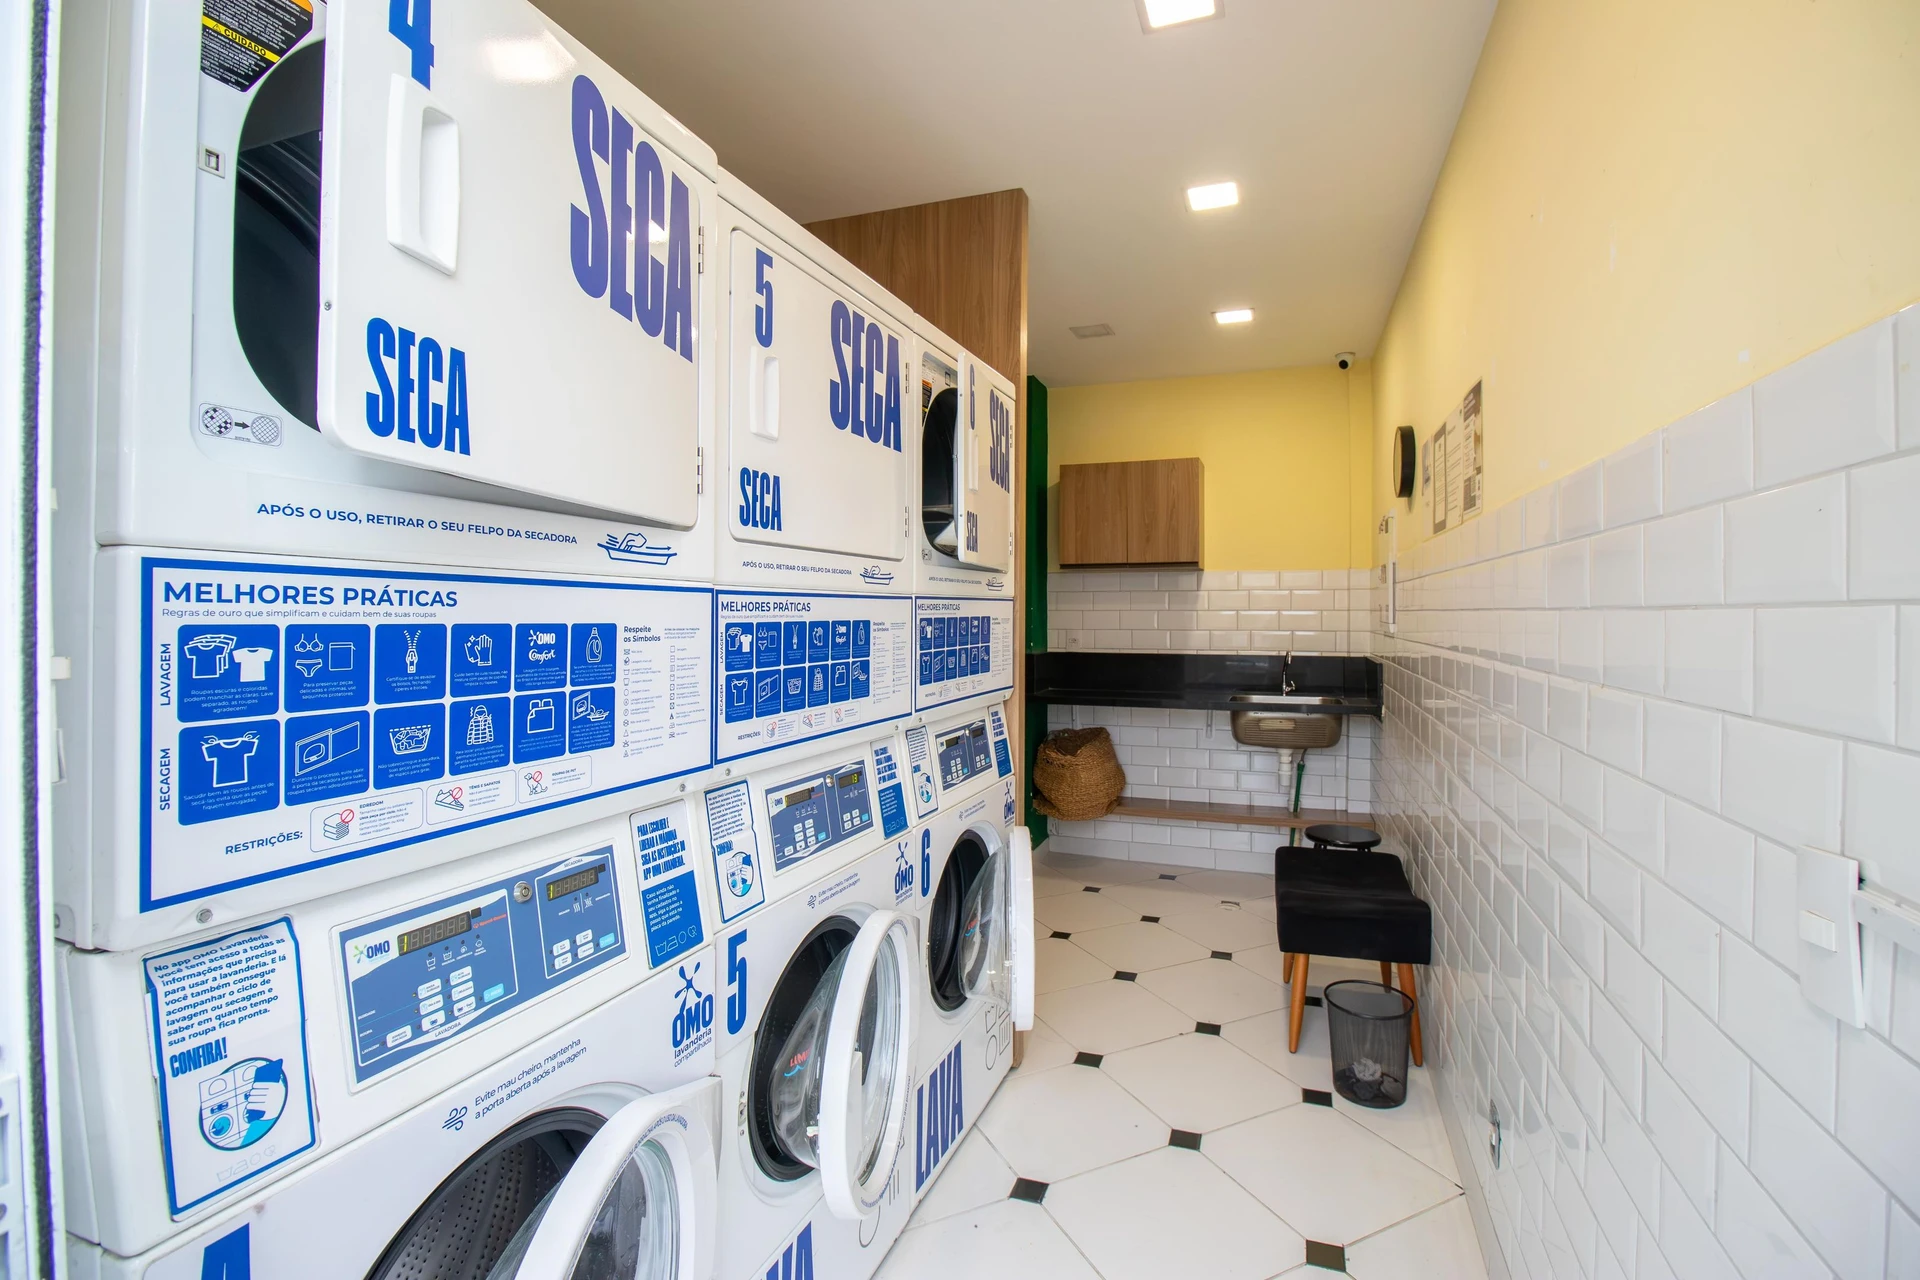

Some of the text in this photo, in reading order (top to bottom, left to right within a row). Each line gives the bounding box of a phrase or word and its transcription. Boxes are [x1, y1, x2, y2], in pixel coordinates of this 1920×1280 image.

[224, 28, 267, 56] CUIDADO
[388, 0, 434, 90] 4
[570, 74, 693, 363] SECA
[755, 247, 774, 349] 5
[365, 317, 471, 456] SECA
[829, 299, 902, 453] SECA
[970, 363, 976, 431] 6
[989, 388, 1010, 494] SECA
[739, 466, 782, 532] SECA
[257, 503, 578, 544] APÓS O USO, RETIRAR O SEU FELPO DA SECADORA
[966, 509, 979, 553] SECA
[162, 608, 200, 618] Regras
[202, 609, 216, 617] de
[244, 610, 264, 618] que
[266, 608, 320, 618] simplificam
[329, 610, 361, 618] cuidam
[362, 610, 381, 618] bem
[164, 581, 458, 607] MELHORES PRÁTICAS
[720, 600, 811, 612] MELHORES PRÁTICAS
[918, 602, 960, 611] MELHORES PRÁTICAS
[538, 633, 556, 645] OMO
[624, 626, 652, 634] Respeite
[632, 634, 661, 642] Símbolos
[160, 643, 172, 706] LAVAGEM
[528, 648, 557, 664] Comfort
[160, 748, 171, 810] SECAGEM
[225, 830, 304, 855] RESTRIÇÕES:
[643, 854, 686, 881] APP OMO LAVANDERIA.
[894, 864, 914, 895] OMO
[921, 828, 931, 898] 6
[154, 934, 269, 972] No app OMO Lavanderia
[157, 968, 183, 979] você
[185, 961, 206, 970] tem
[208, 950, 240, 963] acesso
[250, 940, 274, 952] todas
[162, 948, 277, 986] informações que precisa
[366, 940, 390, 959] OMO
[164, 986, 186, 998] para
[188, 978, 210, 989] usar
[219, 960, 269, 980] lavanderia.
[278, 954, 286, 962] lá
[164, 968, 276, 1006] você também consegue
[728, 928, 748, 1035] 5
[166, 993, 226, 1016] acompanhar
[236, 982, 258, 994] ciclo
[260, 978, 272, 987] de
[166, 1008, 208, 1027] lavagem
[210, 1004, 222, 1012] ou
[224, 990, 266, 1008] secagem
[167, 994, 278, 1036] saber em quanto tempo
[168, 1008, 271, 1047] sua roupa fica pronta.
[434, 1021, 462, 1038] LAVADORA
[672, 993, 714, 1049] OMO
[169, 1036, 228, 1078] CONFIRA!
[674, 1028, 712, 1060] lavanderia
[674, 1036, 712, 1068] compartilhada
[474, 1038, 582, 1107] Evite mau cheiro, mantenha
[474, 1046, 587, 1120] a porta aberta após a lavagem
[915, 1040, 964, 1194] LAVA
